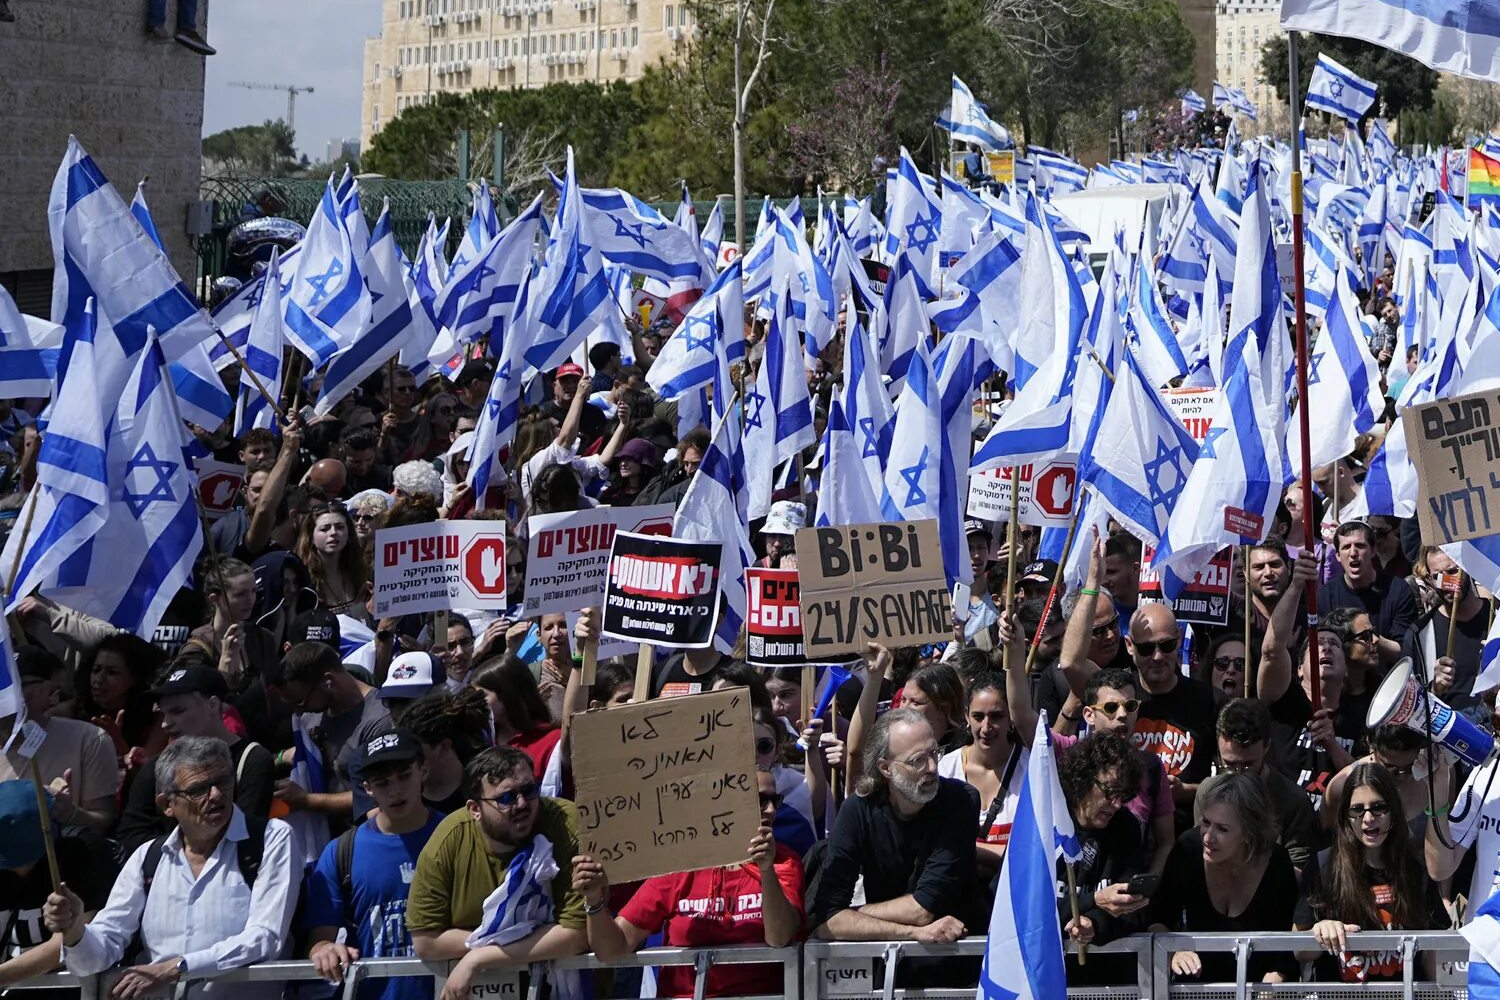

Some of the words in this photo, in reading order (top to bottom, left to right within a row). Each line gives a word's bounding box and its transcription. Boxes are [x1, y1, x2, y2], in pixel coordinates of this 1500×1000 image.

[1421, 397, 1490, 440] העם
[1429, 477, 1490, 543] לרוץ
[537, 523, 617, 559] עוצרים
[384, 535, 459, 567] עוצרים
[403, 564, 443, 577] החקיקה
[445, 563, 459, 572] את
[558, 556, 595, 571] החקיקה
[430, 574, 460, 586] האנטי
[530, 572, 581, 587] דמוקרטית
[584, 569, 607, 580] אנטי
[678, 563, 713, 595] לא
[379, 578, 427, 593] דמוקרטית
[609, 594, 624, 607] פניה
[623, 598, 635, 610] את
[636, 600, 666, 614] שינתה
[667, 603, 693, 616] ארצי
[697, 605, 709, 616] כי
[621, 711, 672, 744] לא
[627, 745, 714, 780] מאמינה
[712, 773, 751, 800] שאני
[578, 792, 641, 829] מפגינה
[656, 780, 694, 825] עדיין
[711, 811, 735, 837] על
[653, 826, 698, 847] החרא
